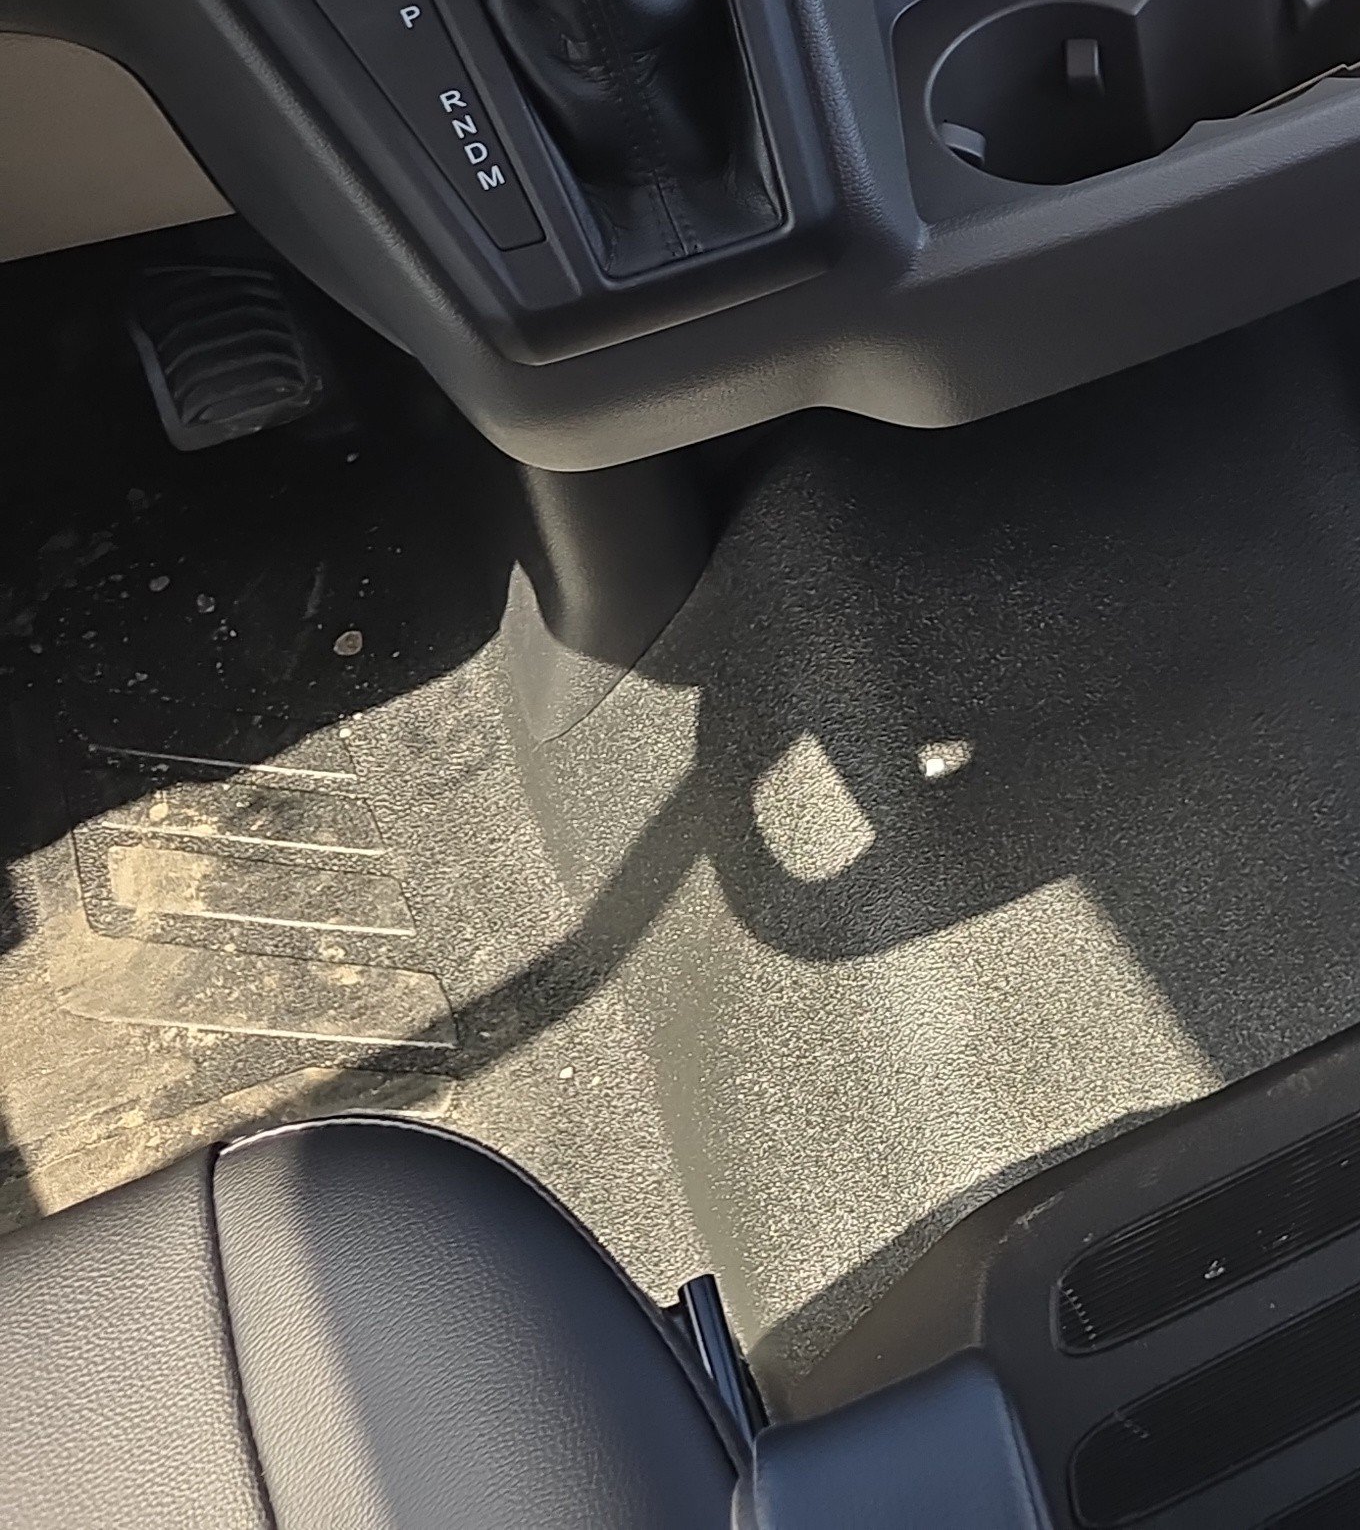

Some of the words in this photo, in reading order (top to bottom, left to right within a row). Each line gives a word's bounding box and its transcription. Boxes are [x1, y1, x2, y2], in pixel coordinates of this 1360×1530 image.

[400, 5, 421, 29] P
[439, 89, 467, 114] R
[451, 114, 478, 139] N
[463, 142, 489, 165] D
[476, 165, 506, 192] M
